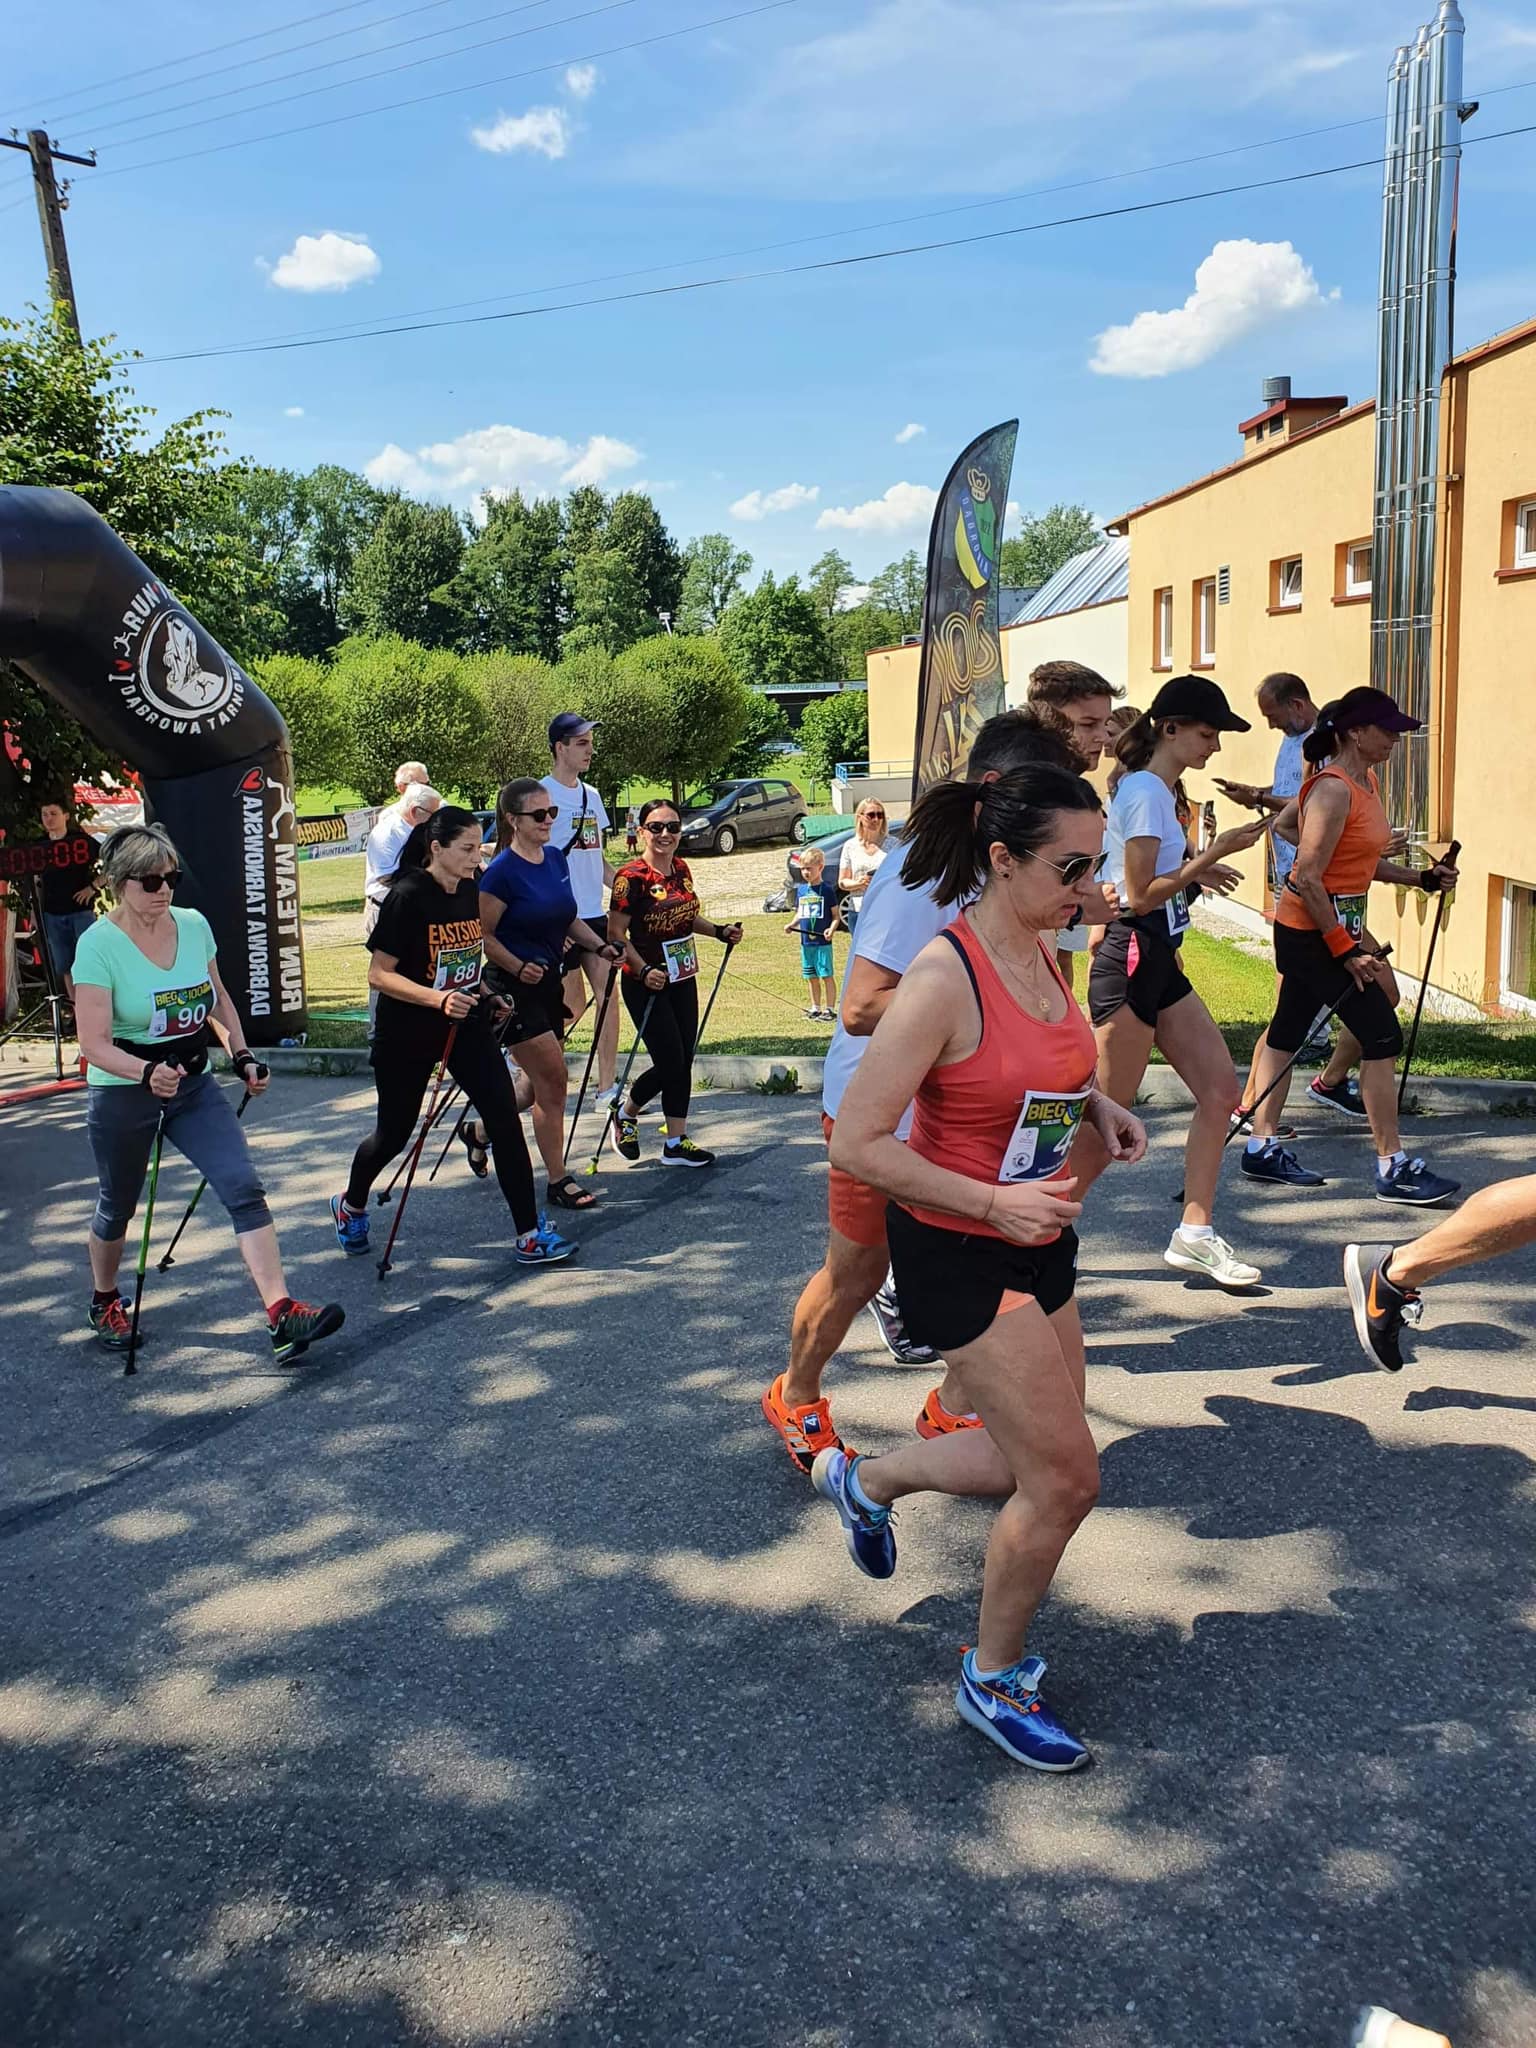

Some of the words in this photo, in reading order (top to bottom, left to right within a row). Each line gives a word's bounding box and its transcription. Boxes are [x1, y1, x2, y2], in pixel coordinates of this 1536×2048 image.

[119, 684, 202, 735] DĄBROWA
[583, 830, 596, 845] 96
[453, 962, 476, 984] 88
[155, 991, 178, 1007] BIEG
[178, 1003, 207, 1029] 90
[1026, 1101, 1067, 1121] BIEG
